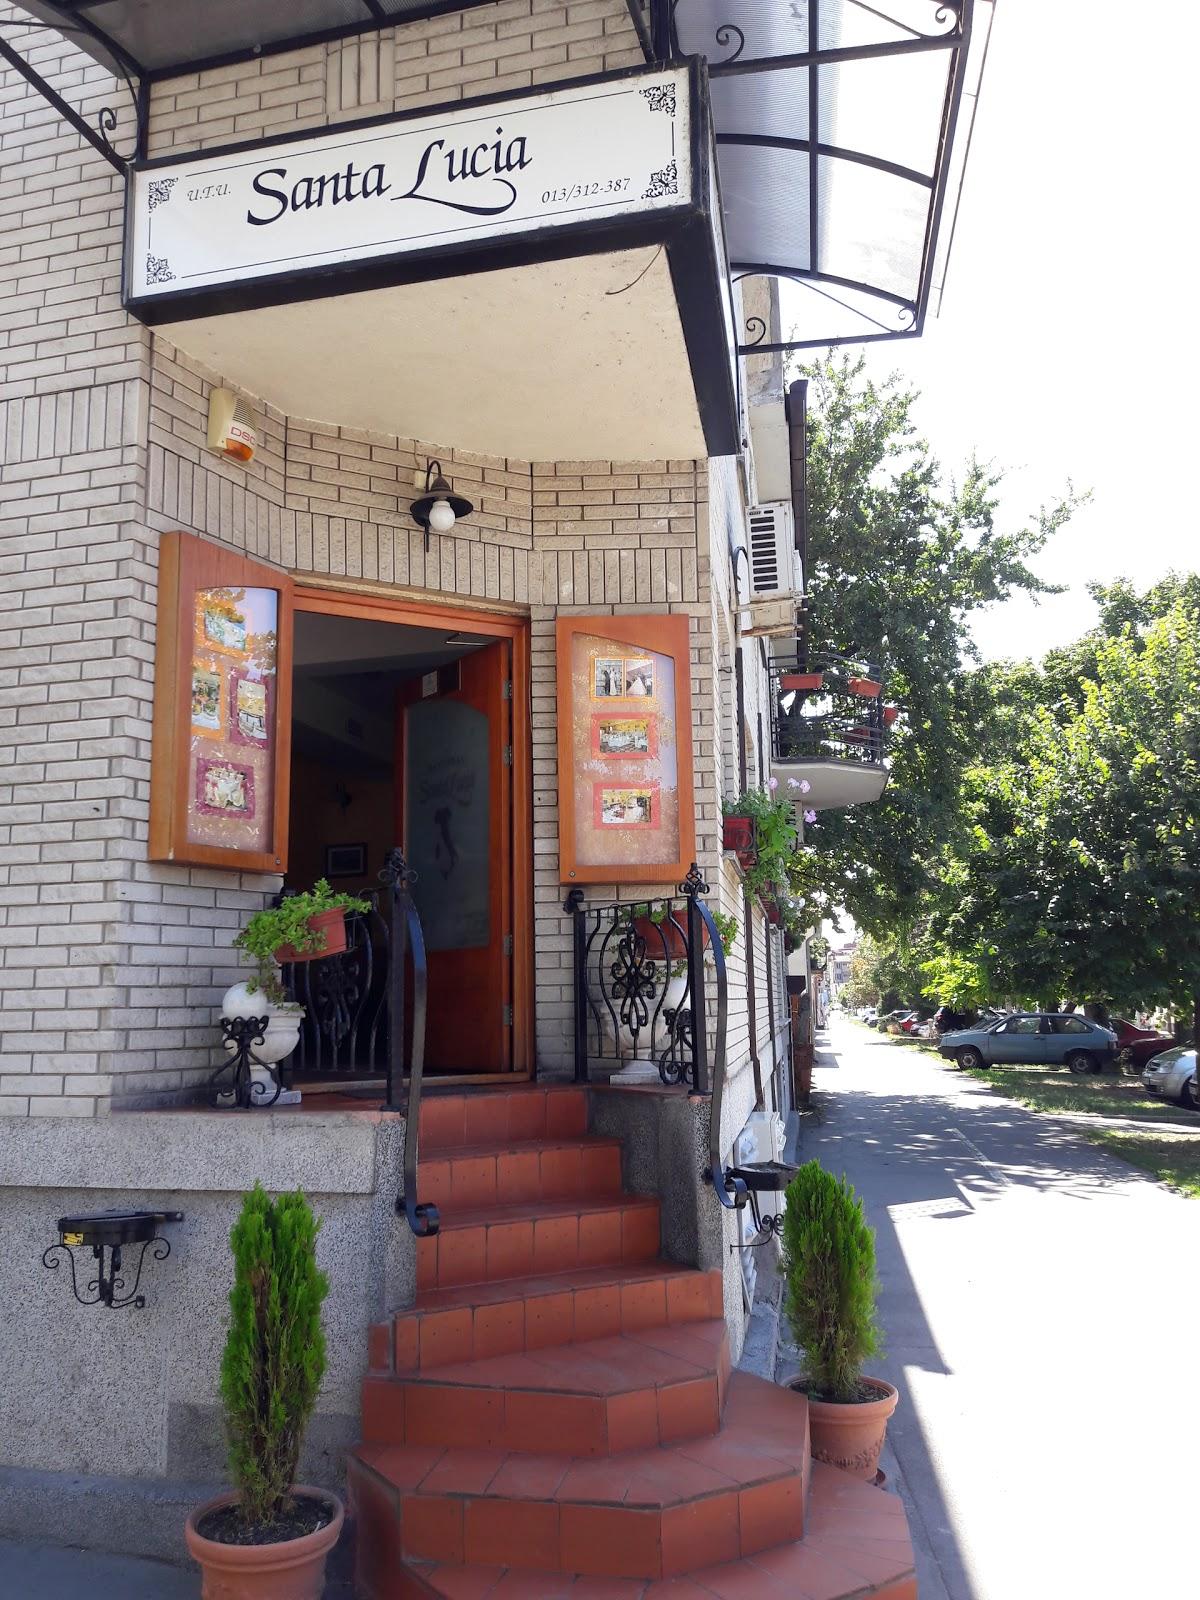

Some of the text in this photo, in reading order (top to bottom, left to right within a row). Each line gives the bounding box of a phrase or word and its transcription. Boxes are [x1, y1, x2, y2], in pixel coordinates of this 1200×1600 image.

[187, 126, 533, 226] U.T.U. Santa Lucia
[541, 177, 631, 204] 013/312-387
[230, 426, 256, 446] DSC
